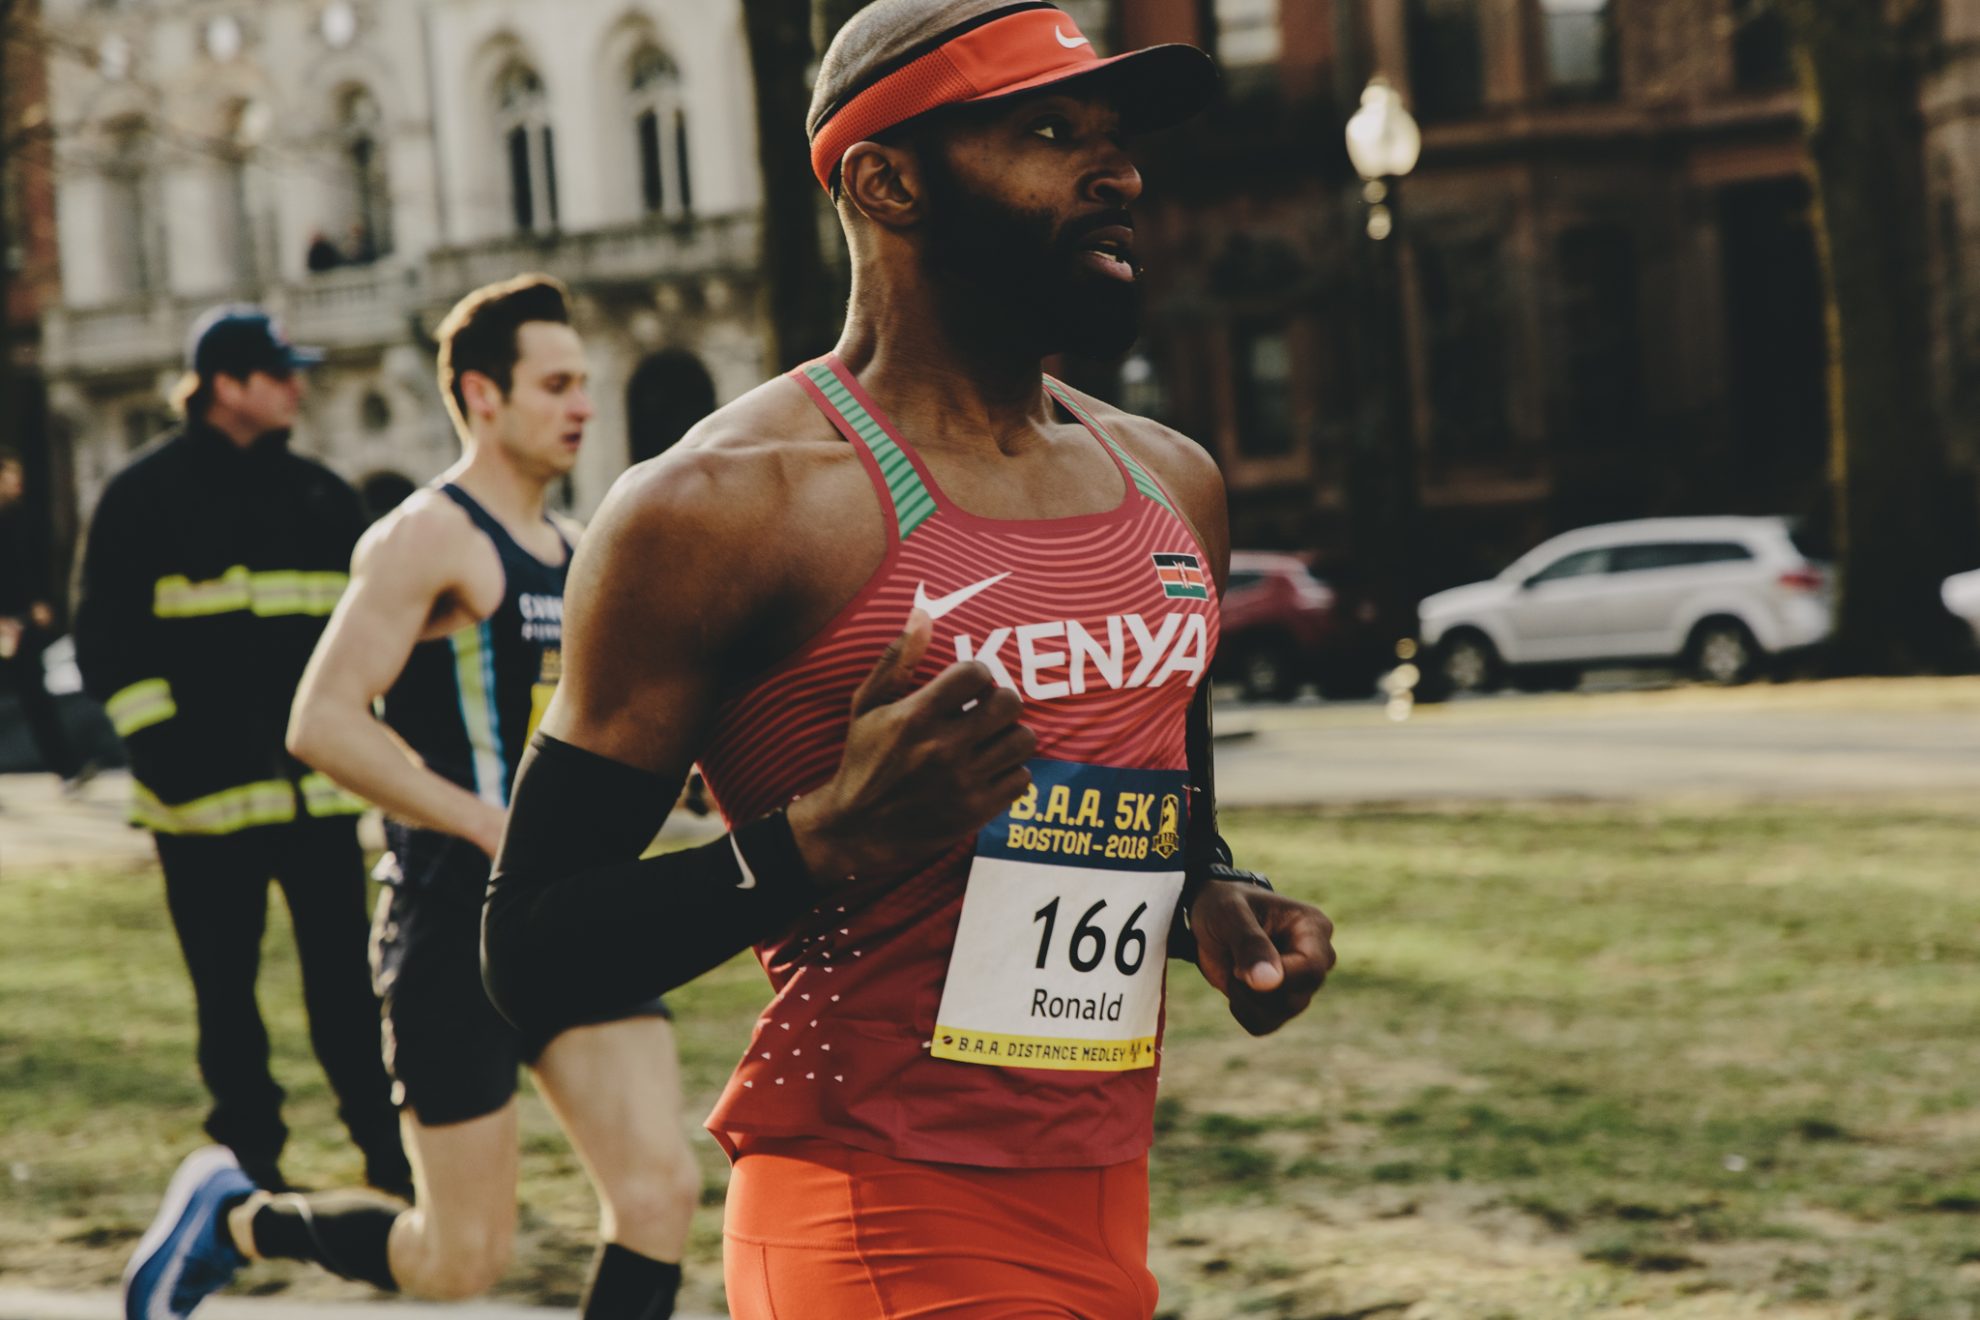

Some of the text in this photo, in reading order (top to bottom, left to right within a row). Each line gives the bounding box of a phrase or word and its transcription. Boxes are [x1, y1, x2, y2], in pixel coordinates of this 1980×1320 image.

[954, 613, 1207, 702] KENYA
[1009, 782, 1155, 831] B.A.A. 5K
[1033, 896, 1148, 976] 166
[1031, 988, 1123, 1021] Ronald
[958, 1037, 1127, 1062] B.A.A. DISTANCE MEDLEY
